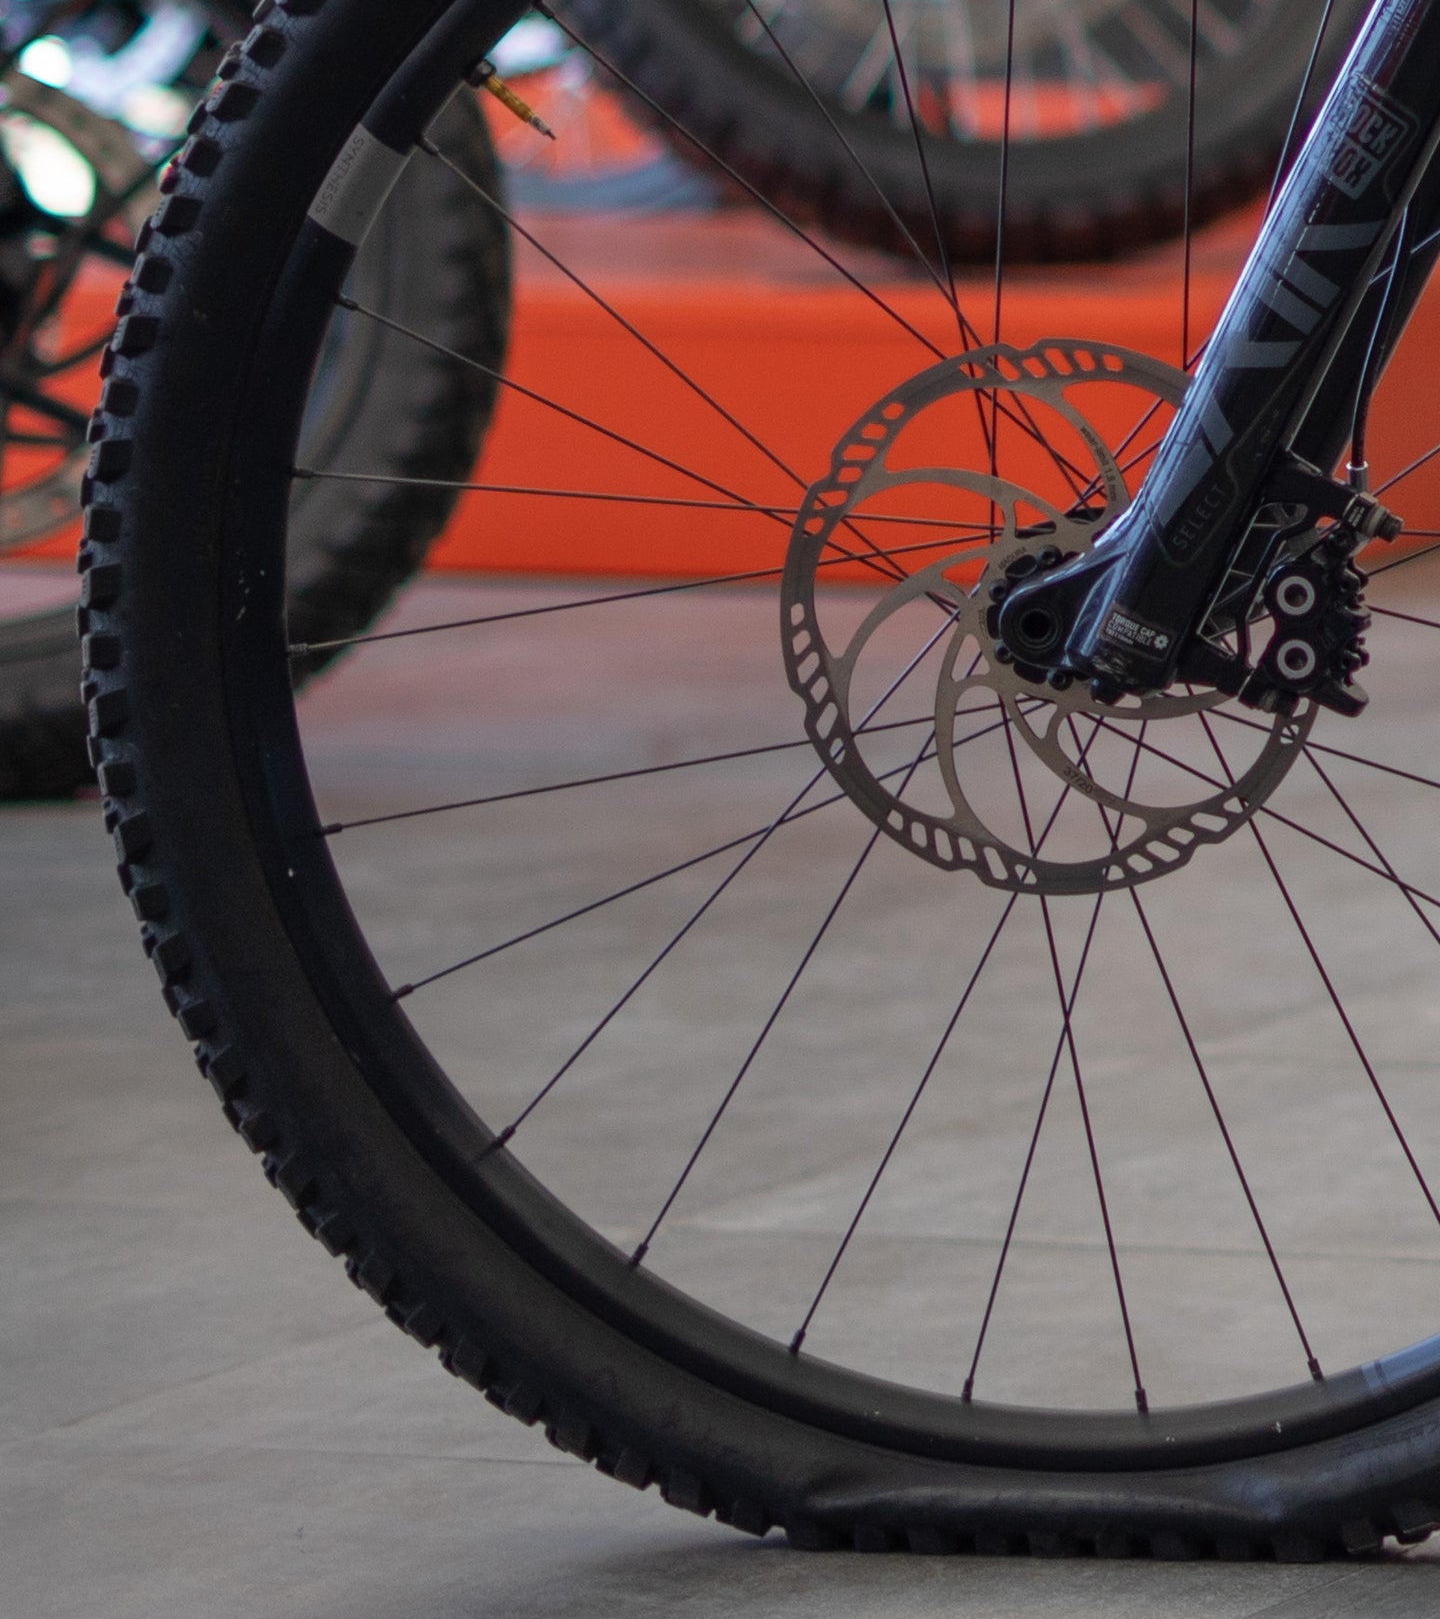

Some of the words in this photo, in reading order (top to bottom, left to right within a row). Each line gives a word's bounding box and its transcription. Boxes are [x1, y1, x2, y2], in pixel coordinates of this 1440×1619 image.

[315, 135, 365, 215] SYNTHESIS
[1172, 483, 1226, 550] SELECT
[1112, 612, 1140, 631] TORQUE
[1140, 626, 1157, 638] CAP
